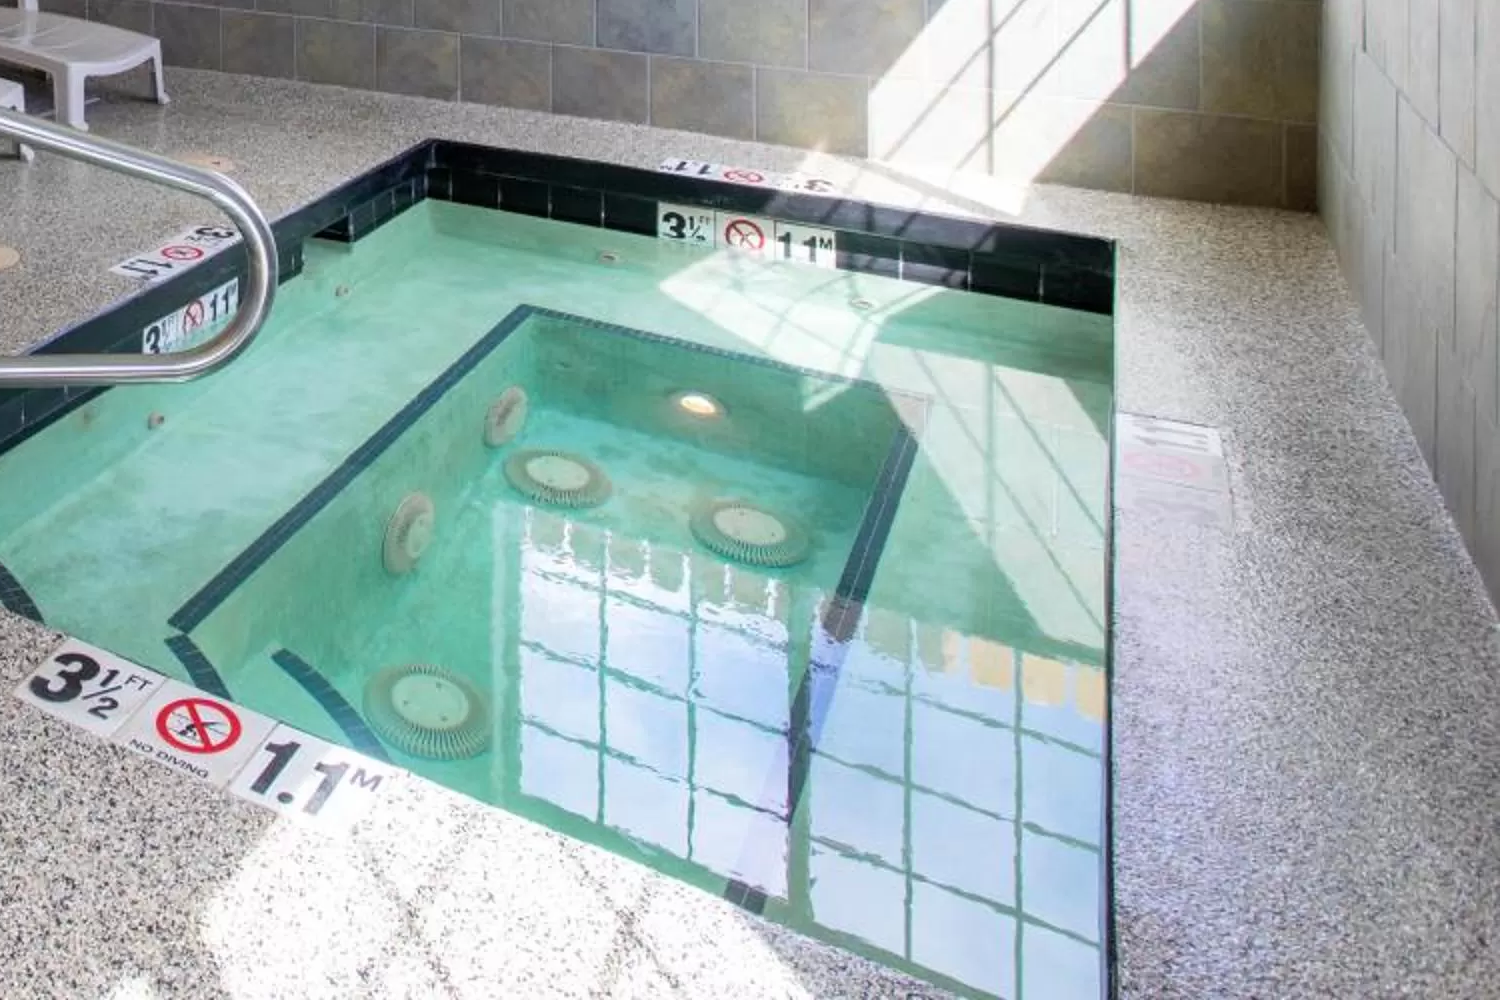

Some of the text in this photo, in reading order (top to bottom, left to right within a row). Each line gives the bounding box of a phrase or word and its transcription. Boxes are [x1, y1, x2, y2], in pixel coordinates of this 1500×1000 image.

[819, 236, 833, 251] M
[124, 673, 154, 692] FT
[128, 738, 210, 779] NO DIVING
[250, 740, 385, 815] 1.1 M
